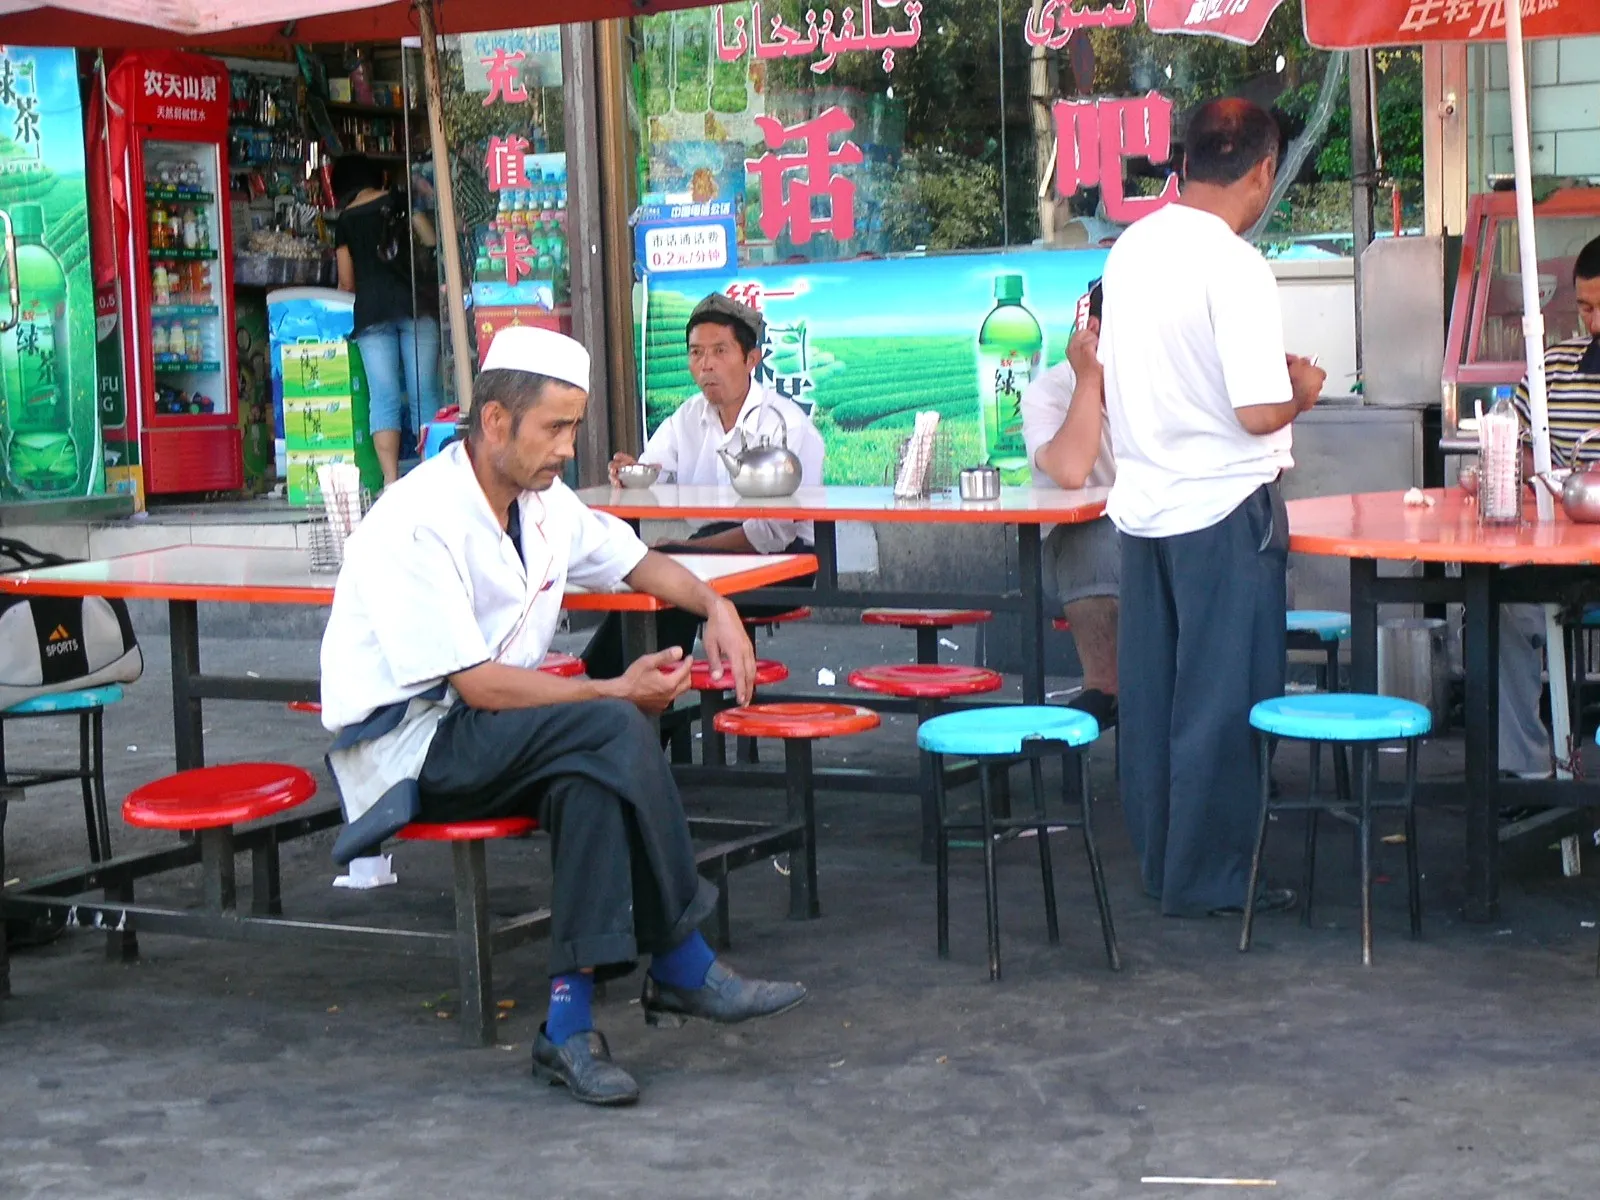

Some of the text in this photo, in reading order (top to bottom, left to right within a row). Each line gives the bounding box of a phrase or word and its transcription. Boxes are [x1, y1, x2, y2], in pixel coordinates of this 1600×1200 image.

[479, 47, 537, 286] 充值卡
[46, 639, 78, 657] SPORTS
